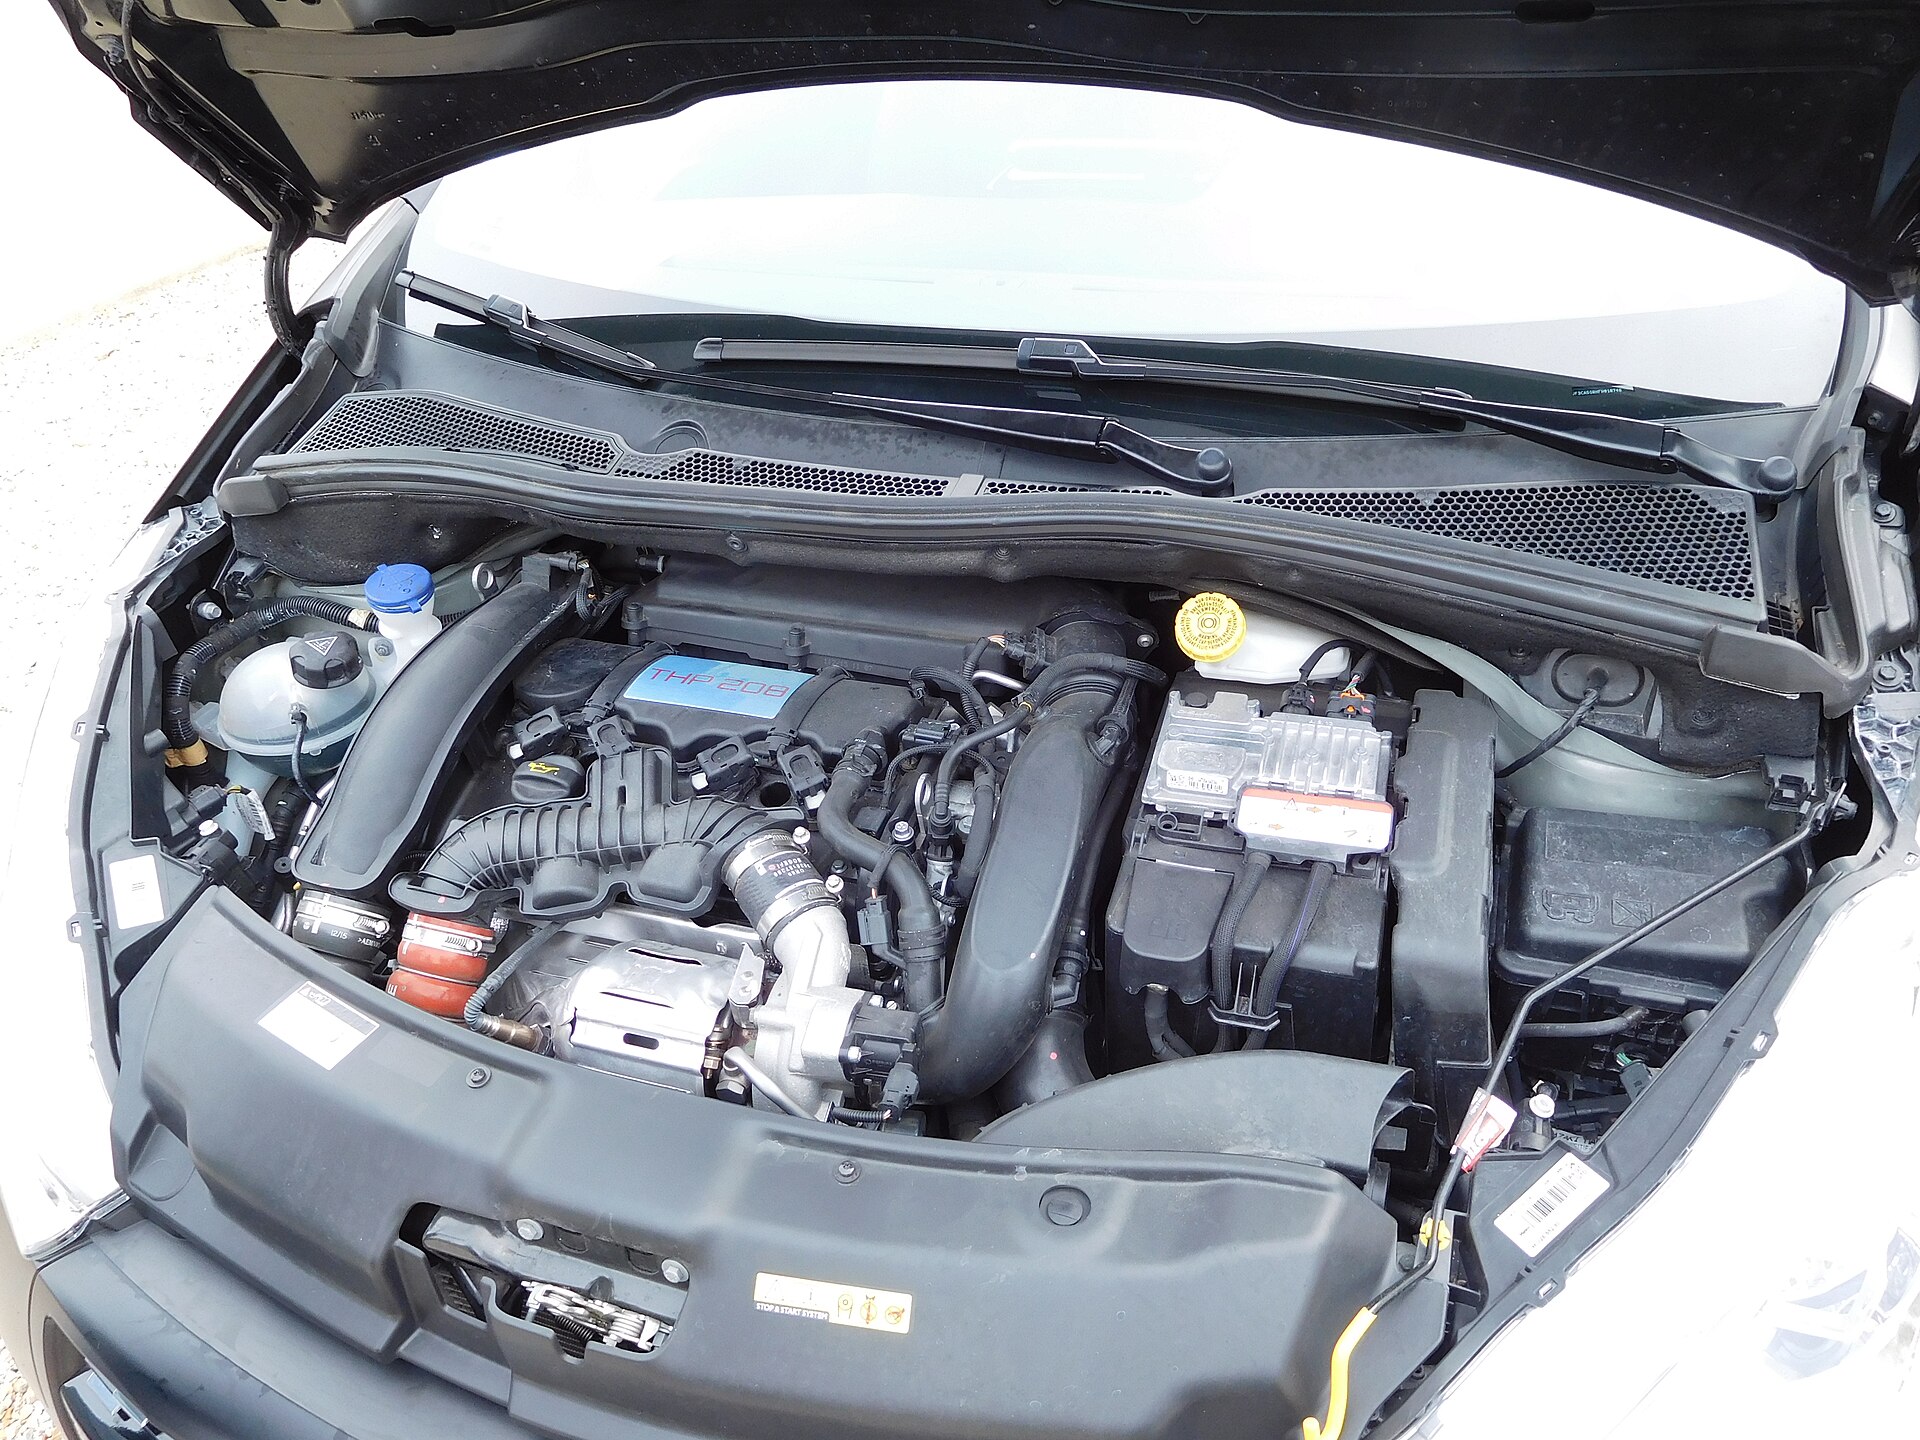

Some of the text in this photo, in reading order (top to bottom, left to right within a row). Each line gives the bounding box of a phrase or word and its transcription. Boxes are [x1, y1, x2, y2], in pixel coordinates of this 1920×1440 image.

[652, 667, 790, 698] THP 208
[330, 929, 348, 940] 12/15
[756, 1302, 774, 1313] STOP
[780, 1306, 801, 1316] START
[801, 1309, 829, 1320] SYSTEM
